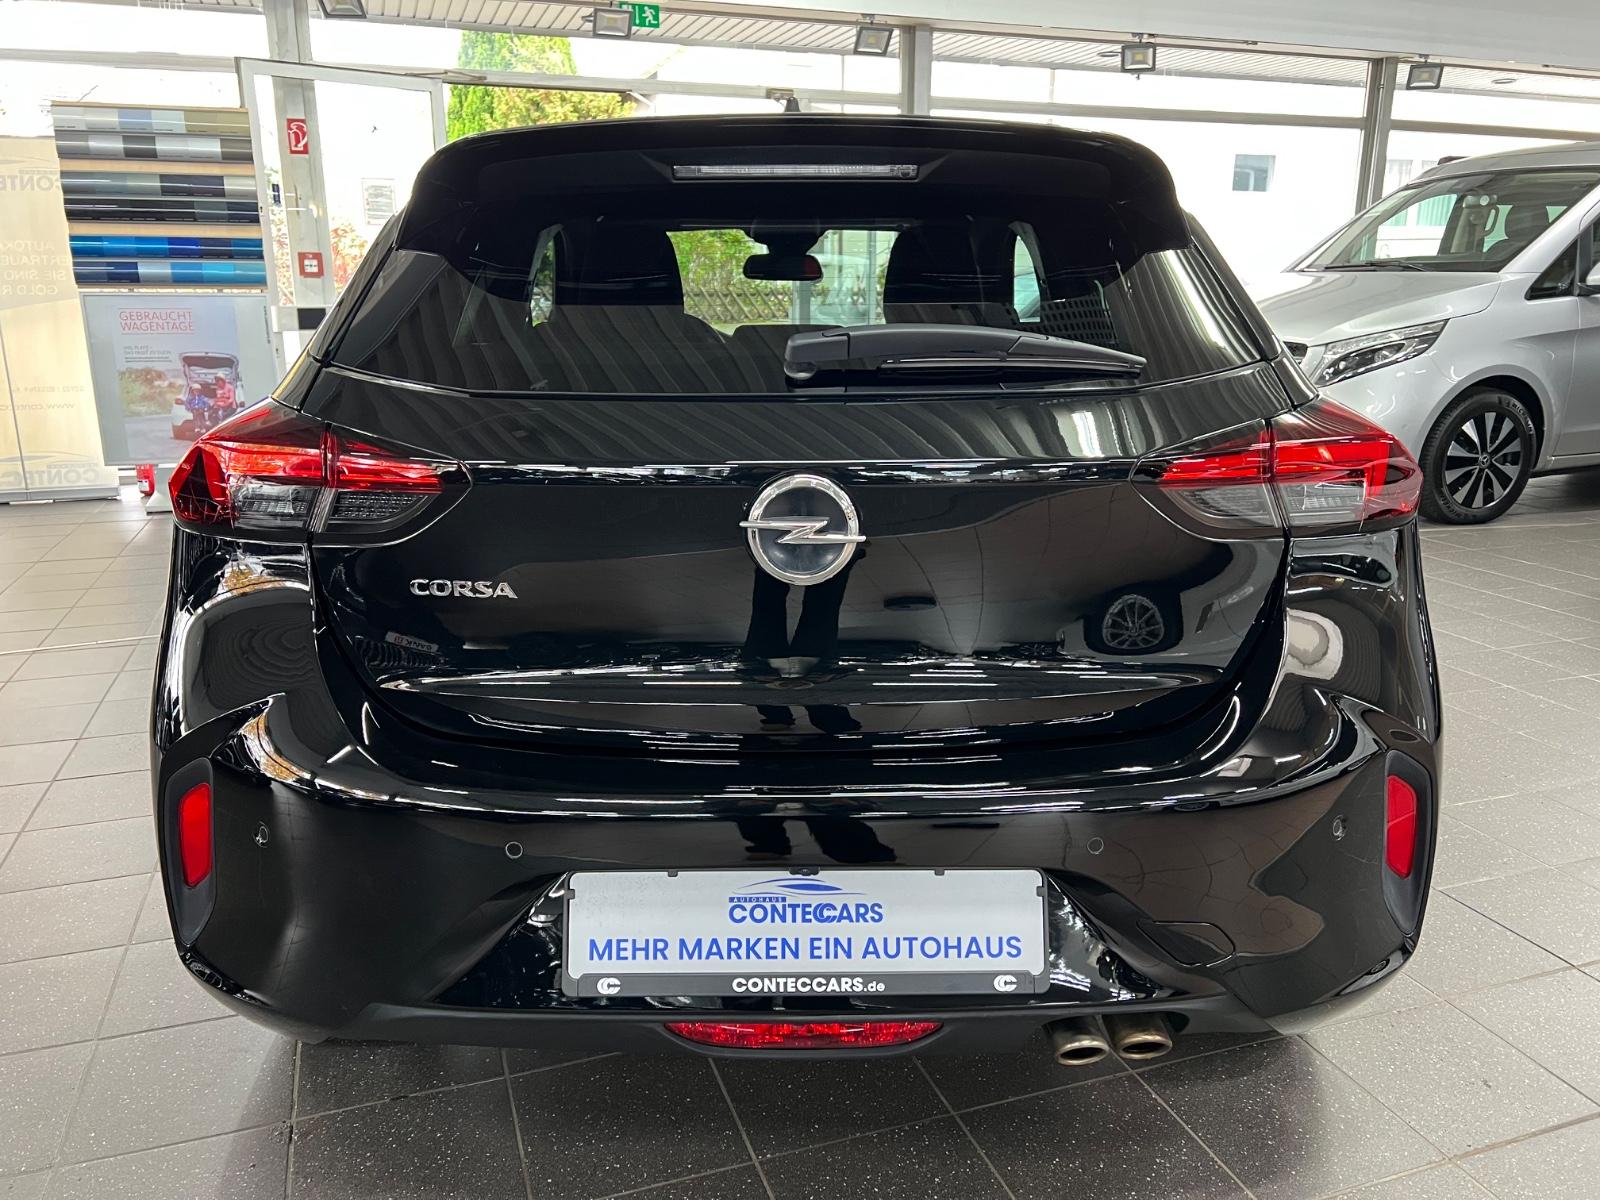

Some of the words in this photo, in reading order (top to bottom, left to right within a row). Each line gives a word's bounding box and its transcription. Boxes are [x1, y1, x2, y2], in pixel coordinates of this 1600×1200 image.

[119, 311, 193, 321] GEBRAUCHT
[120, 321, 195, 332] WAGENTAGE
[409, 579, 518, 599] CORSA
[728, 903, 884, 924] CONTECCARS
[588, 938, 669, 961] MEHR
[678, 937, 799, 960] MARKEN
[809, 937, 853, 960] EIN
[861, 936, 1022, 960] AUTOHAUS
[732, 977, 886, 993] CONTECCARS.de
